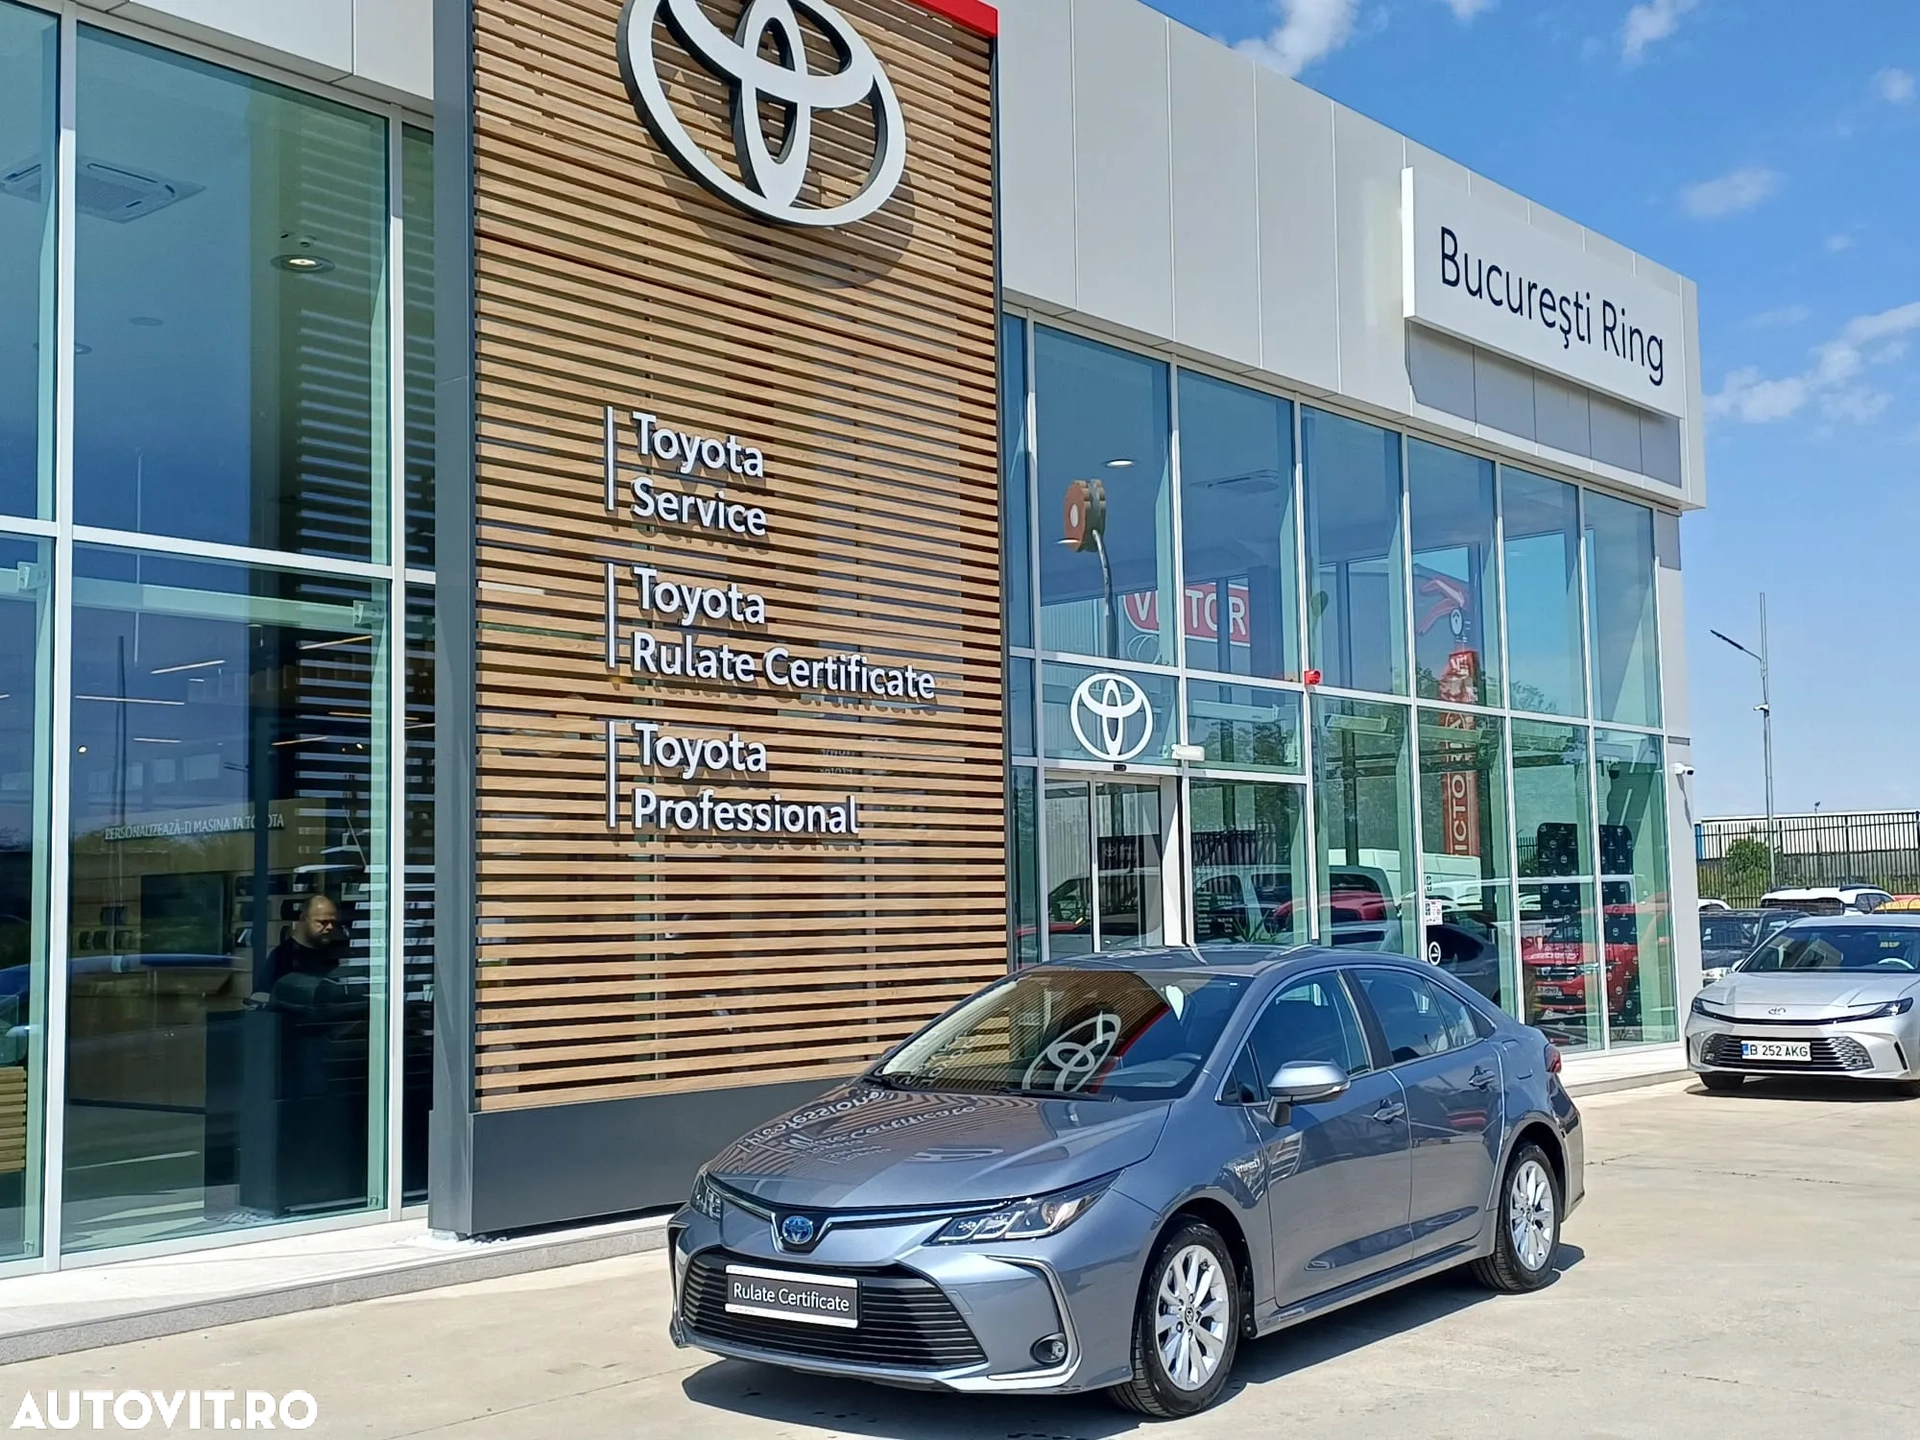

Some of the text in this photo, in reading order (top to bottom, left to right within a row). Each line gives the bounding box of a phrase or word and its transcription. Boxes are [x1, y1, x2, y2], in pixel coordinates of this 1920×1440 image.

[1602, 299, 1663, 386] Ring
[631, 411, 764, 477] Toyota
[632, 477, 768, 536] Service
[633, 566, 765, 625] Toyota
[633, 631, 936, 699] Rulate Certificate
[634, 722, 767, 780] Toyota
[245, 813, 285, 829] TOOTA
[636, 788, 860, 835] Professional
[1749, 1044, 1808, 1057] B 252 AKG
[733, 1282, 850, 1312] Rulate Certificate
